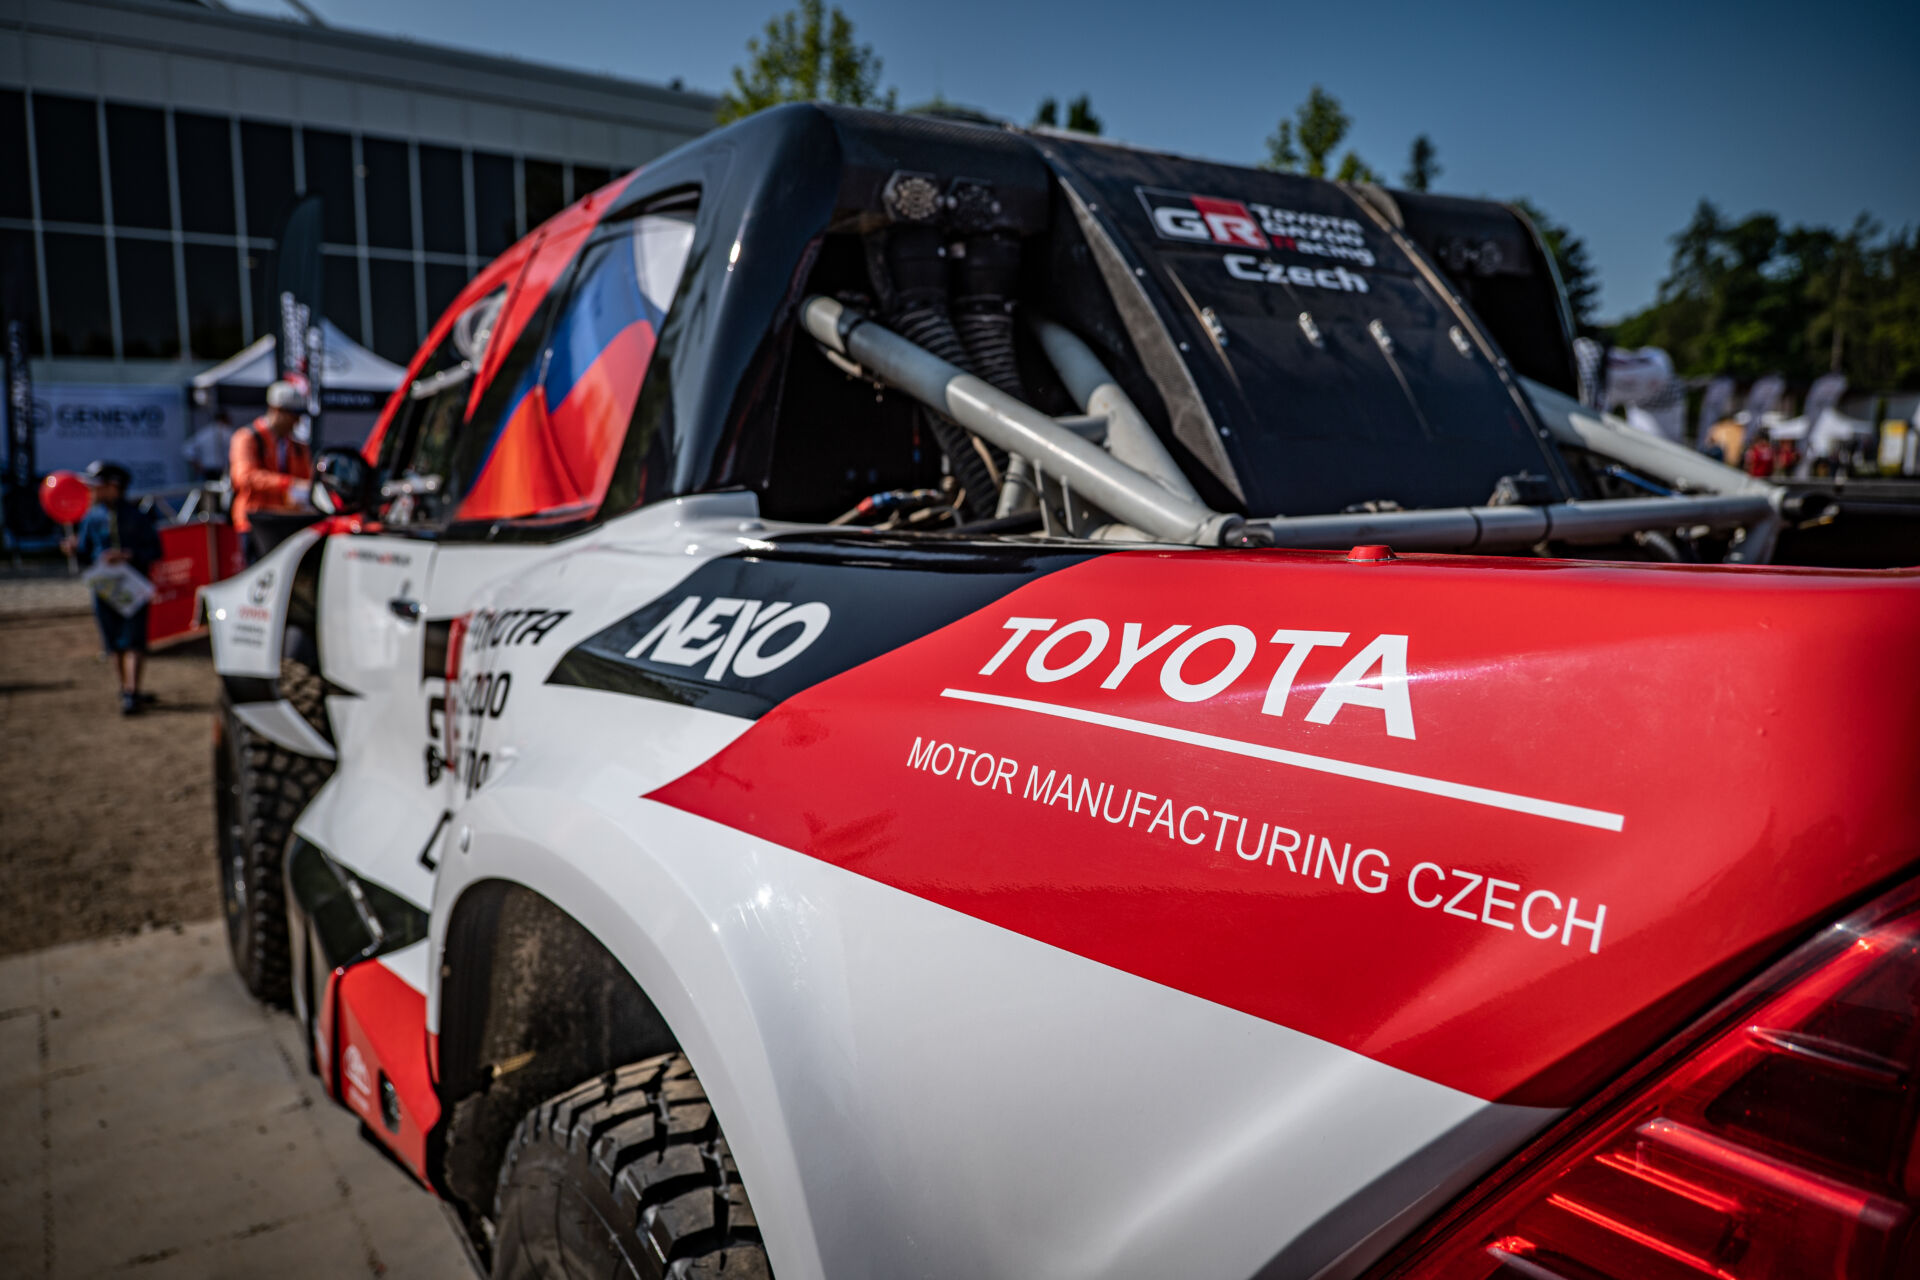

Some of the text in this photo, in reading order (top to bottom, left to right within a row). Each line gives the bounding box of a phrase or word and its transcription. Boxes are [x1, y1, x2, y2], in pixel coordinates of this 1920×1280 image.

[1153, 206, 1268, 250] GR
[1223, 253, 1370, 293] Czech
[624, 596, 831, 682] NEXO
[979, 616, 1416, 740] TOYOTA
[906, 736, 1607, 954] MOTOR MANUFACTURING CZECH
